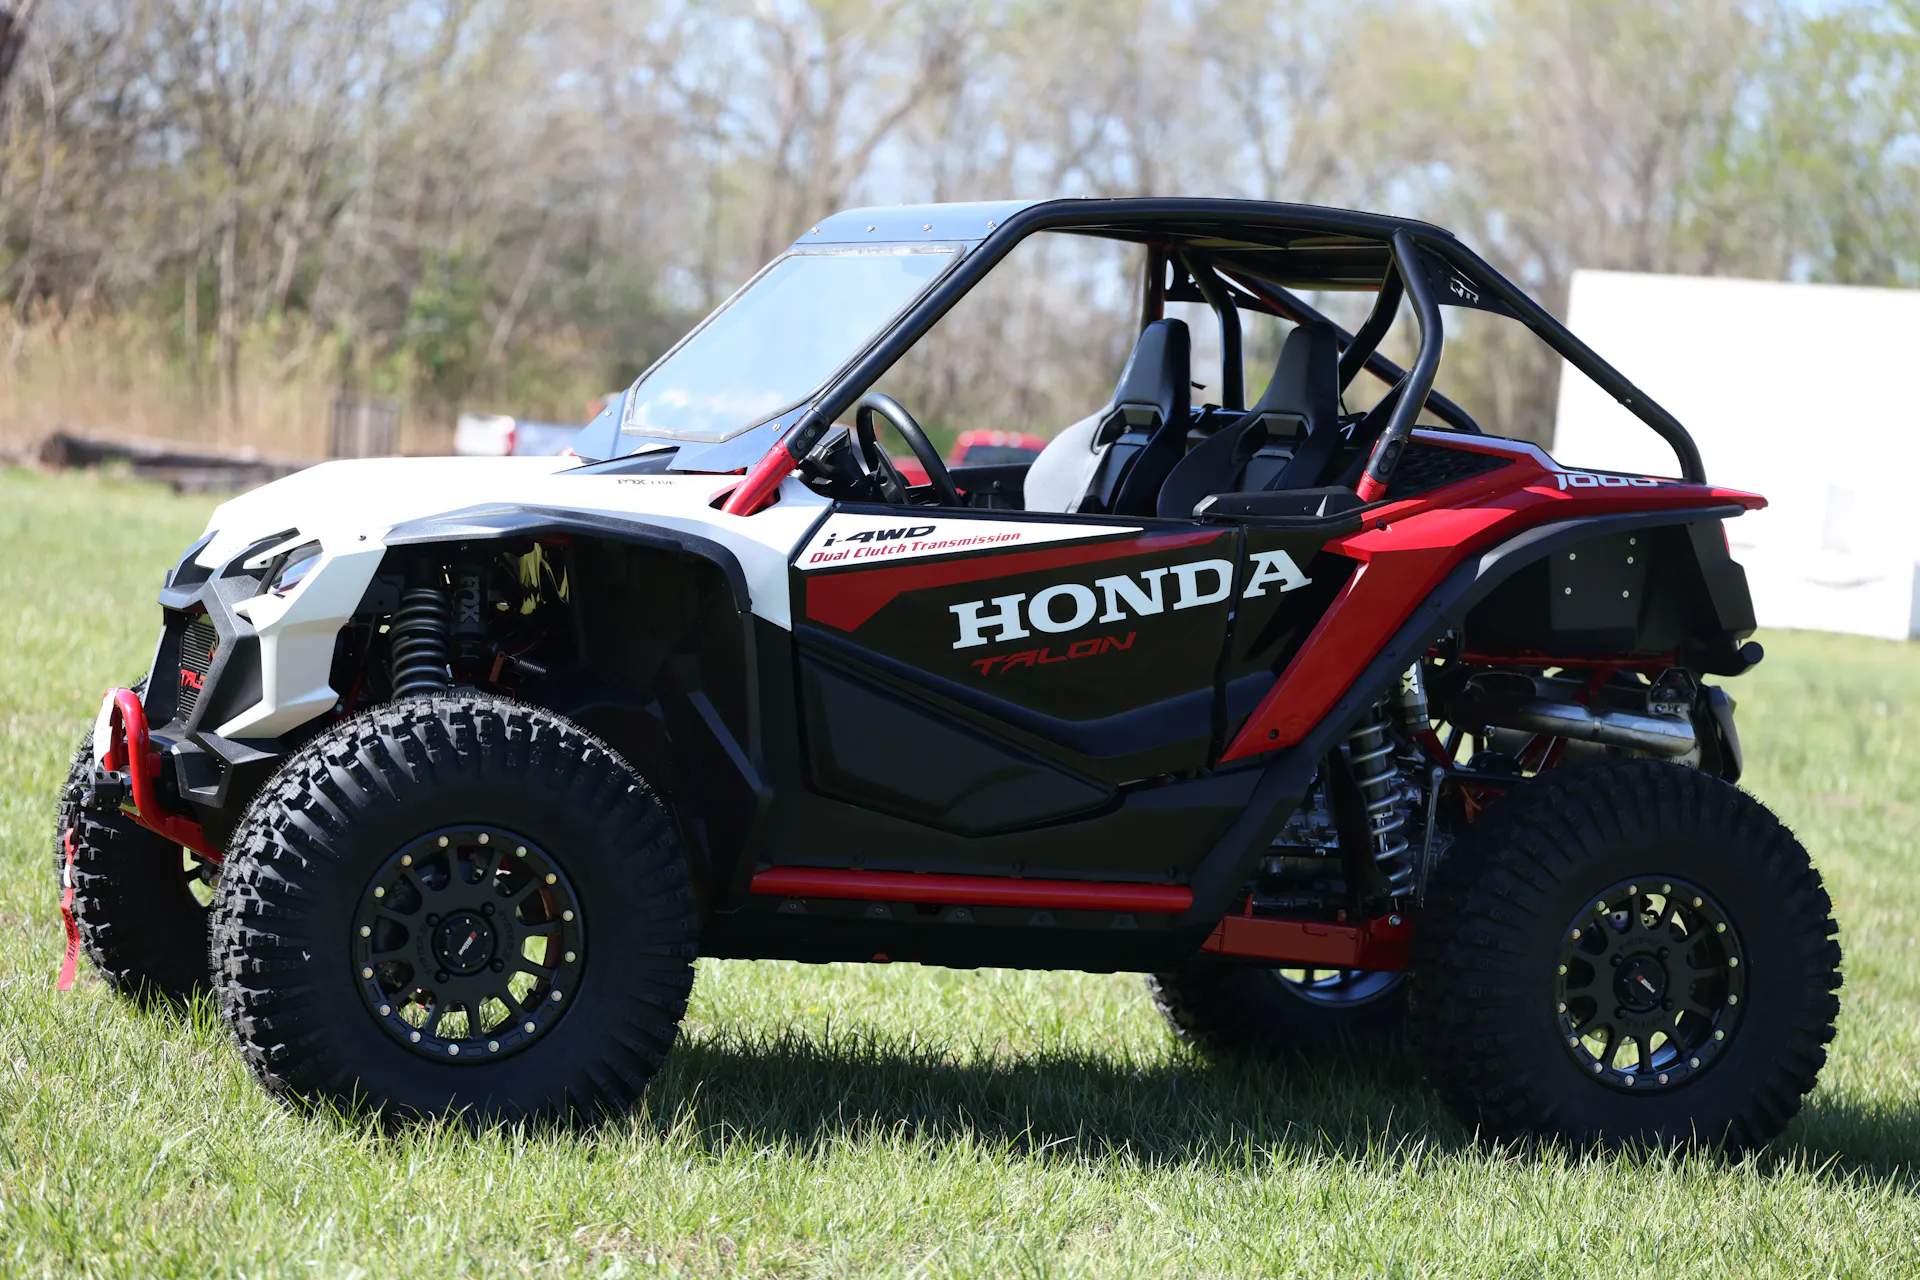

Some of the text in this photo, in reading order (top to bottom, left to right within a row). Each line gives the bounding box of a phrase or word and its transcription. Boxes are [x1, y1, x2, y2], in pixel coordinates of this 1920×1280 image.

[809, 532, 1021, 563] Dual Clutch Transmission
[823, 525, 937, 547] i-4WD
[460, 576, 480, 622] FOX
[949, 549, 1312, 649] HONDA
[970, 631, 1137, 676] TALON
